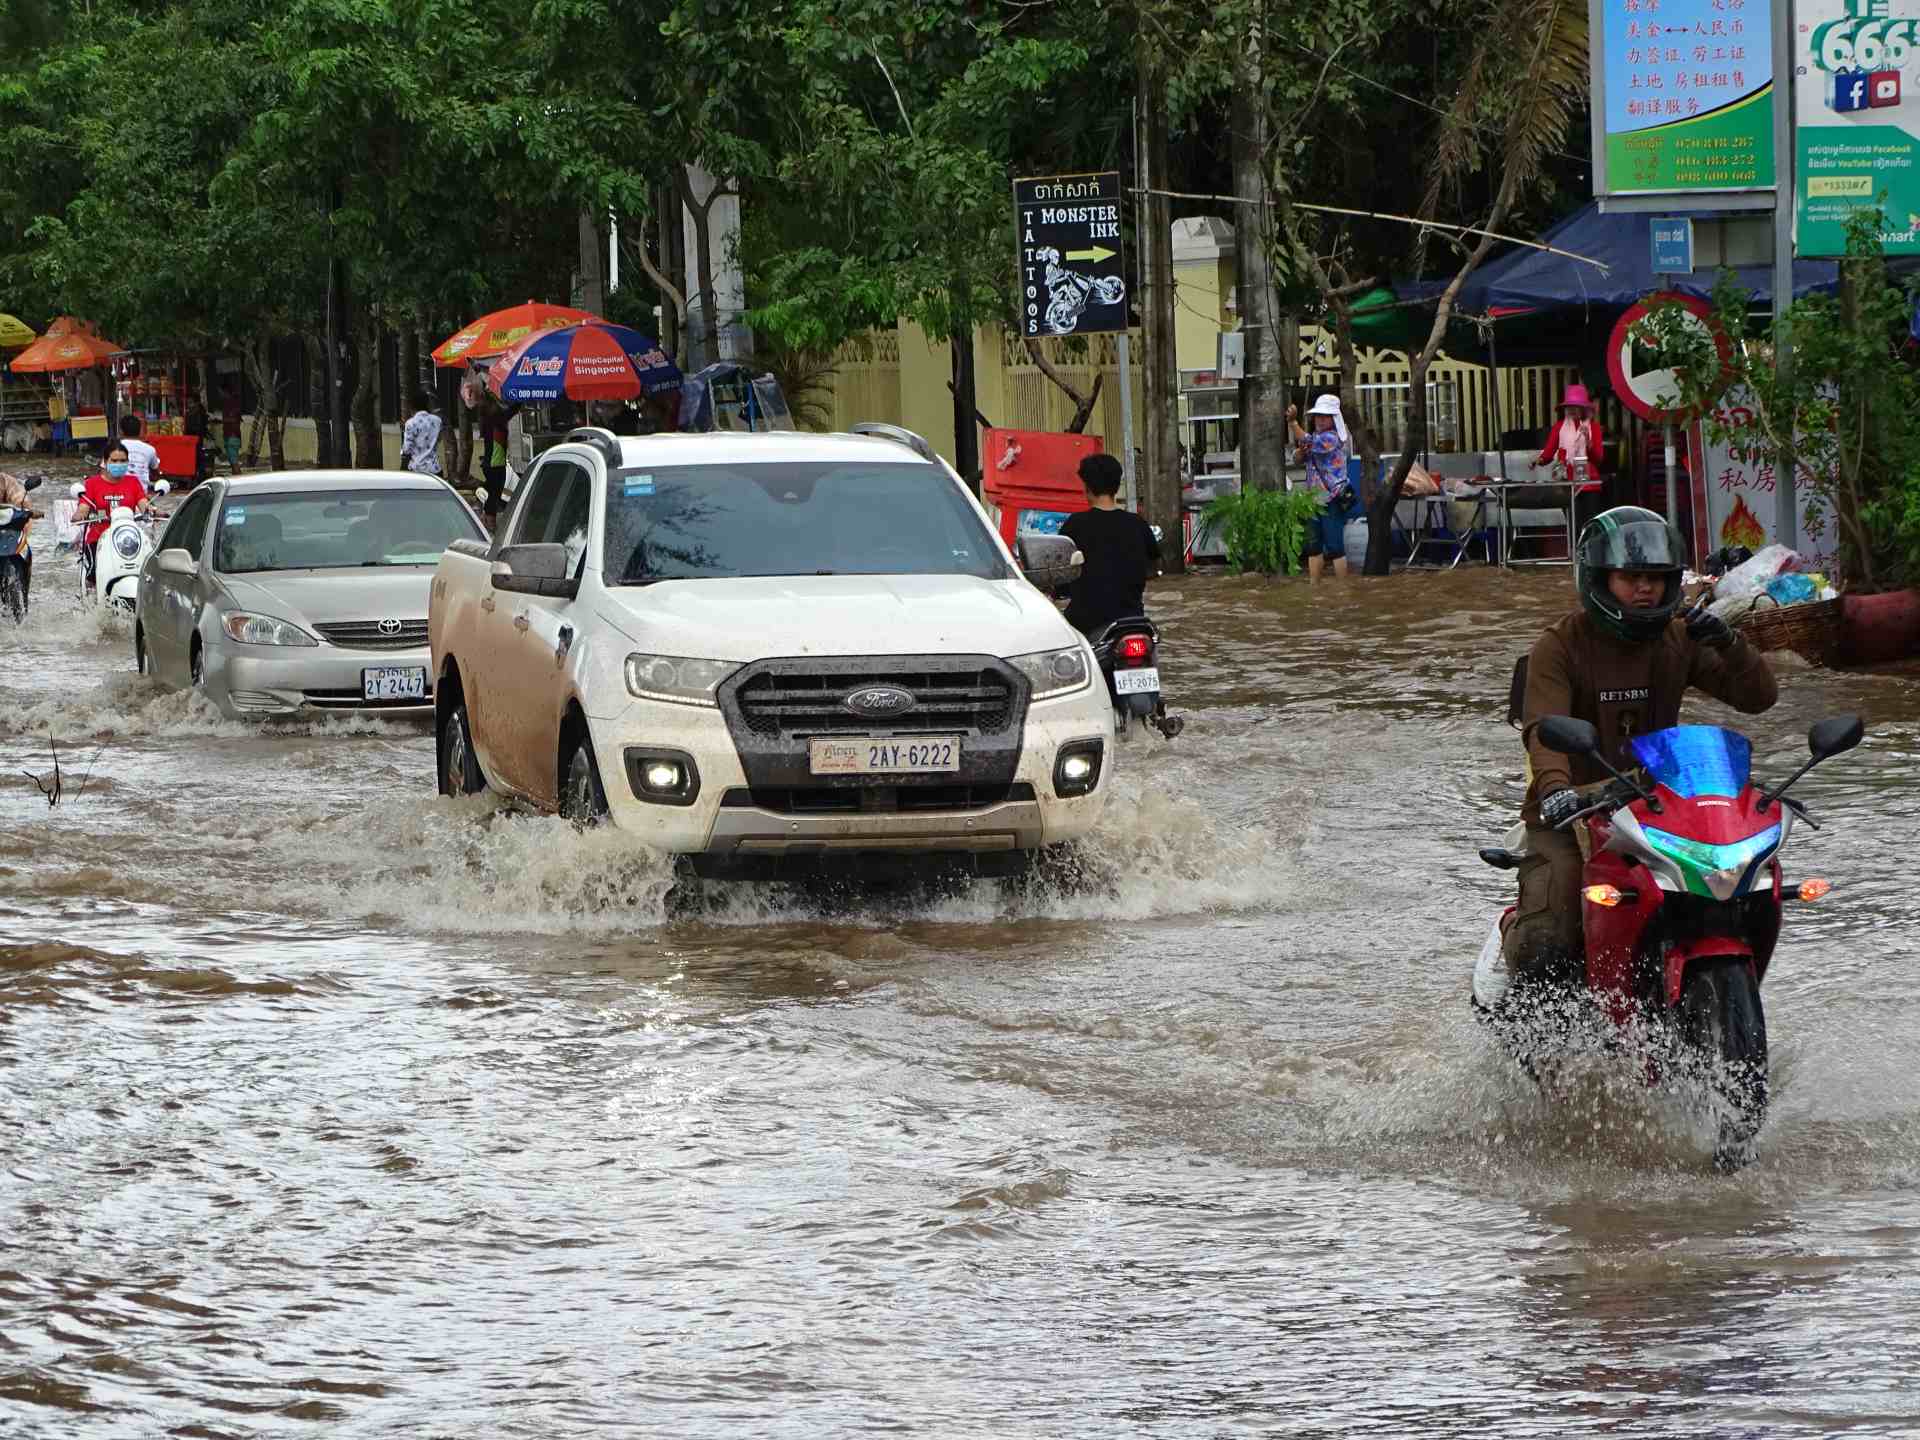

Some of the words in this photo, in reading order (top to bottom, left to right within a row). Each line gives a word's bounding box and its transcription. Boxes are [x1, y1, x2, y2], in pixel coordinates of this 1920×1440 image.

[1694, 19, 1744, 37] 人民币
[1041, 206, 1118, 225] MONSTER
[1090, 222, 1120, 238] INK
[1024, 211, 1038, 333] TATTOOS
[574, 365, 625, 376] Singapore
[367, 679, 422, 695] 2Y-2447
[864, 692, 897, 707] Ford
[869, 744, 952, 767] 2AY-6222
